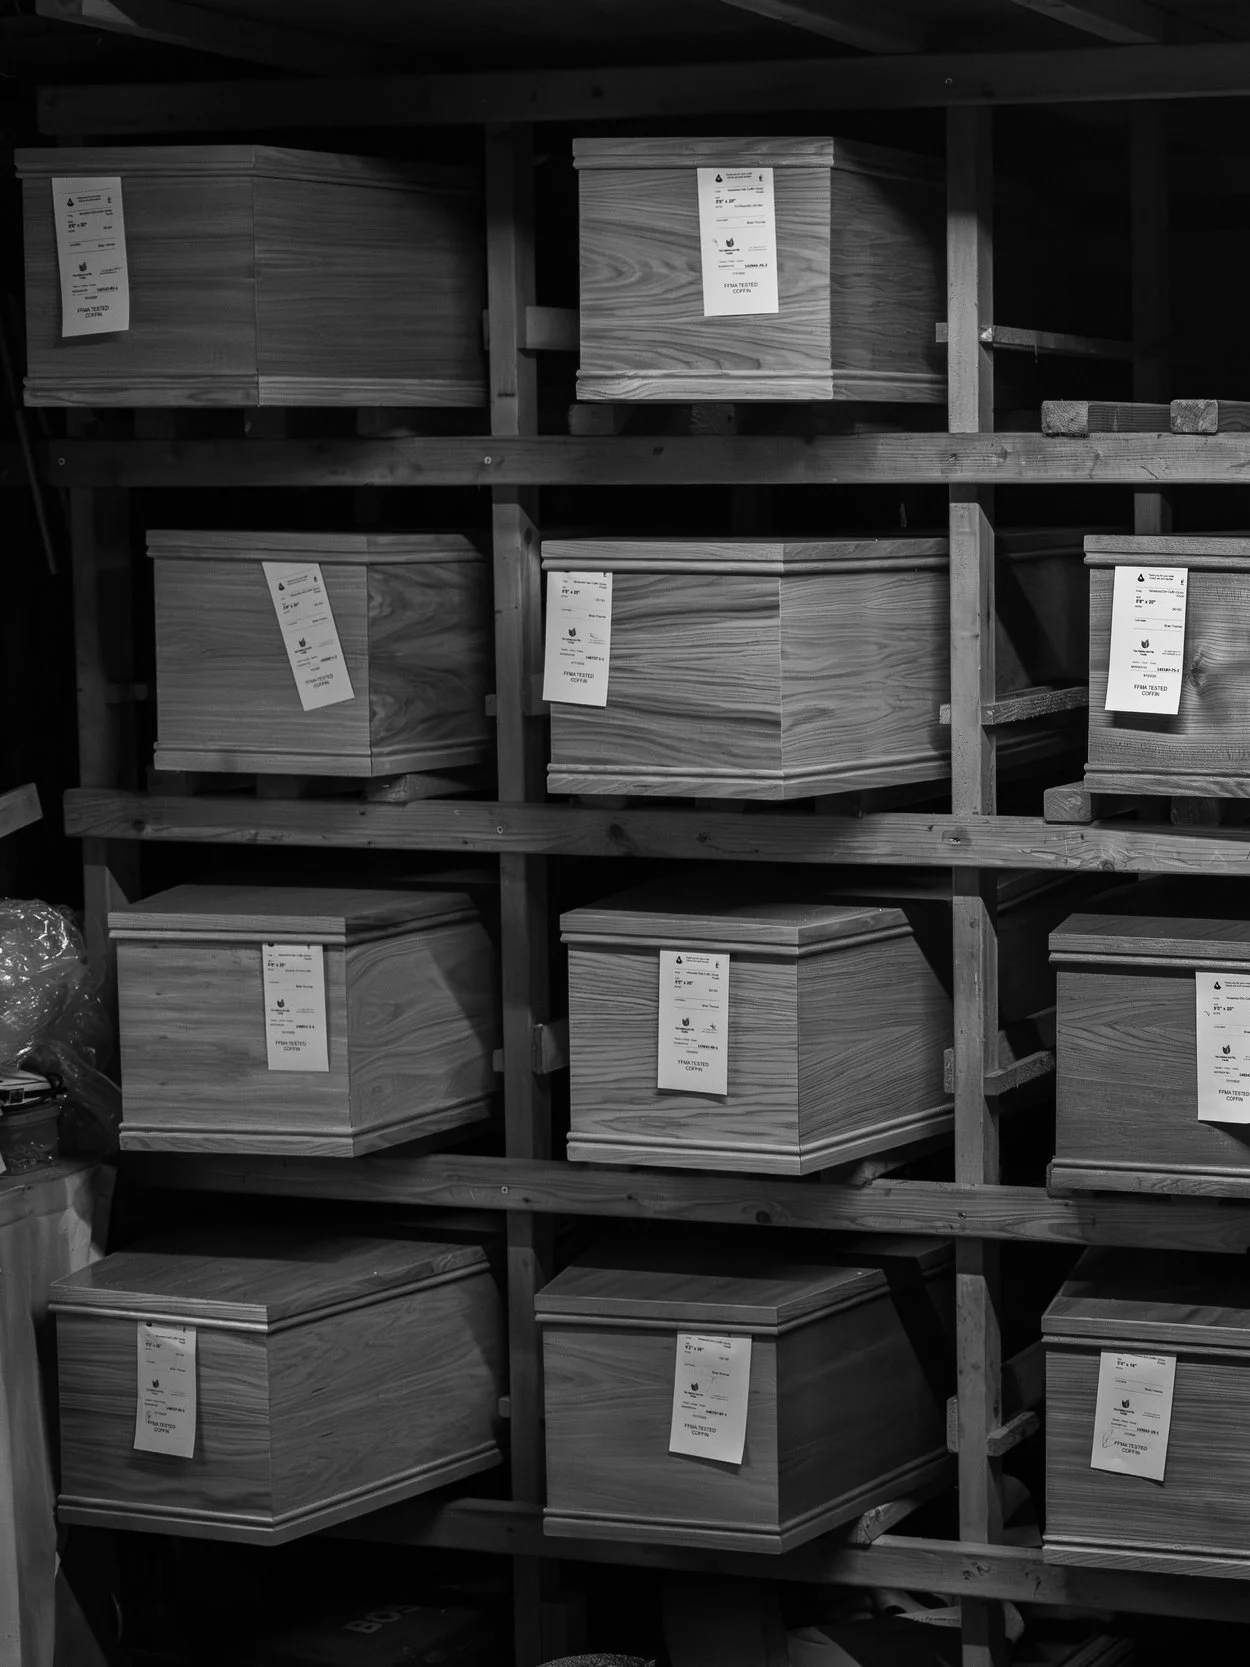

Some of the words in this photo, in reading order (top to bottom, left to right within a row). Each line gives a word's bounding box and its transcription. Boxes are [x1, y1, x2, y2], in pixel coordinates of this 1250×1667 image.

[698, 1425, 717, 1433] TESTED
[691, 1430, 709, 1438] COFFIN
[1128, 1443, 1148, 1451] TESTED
